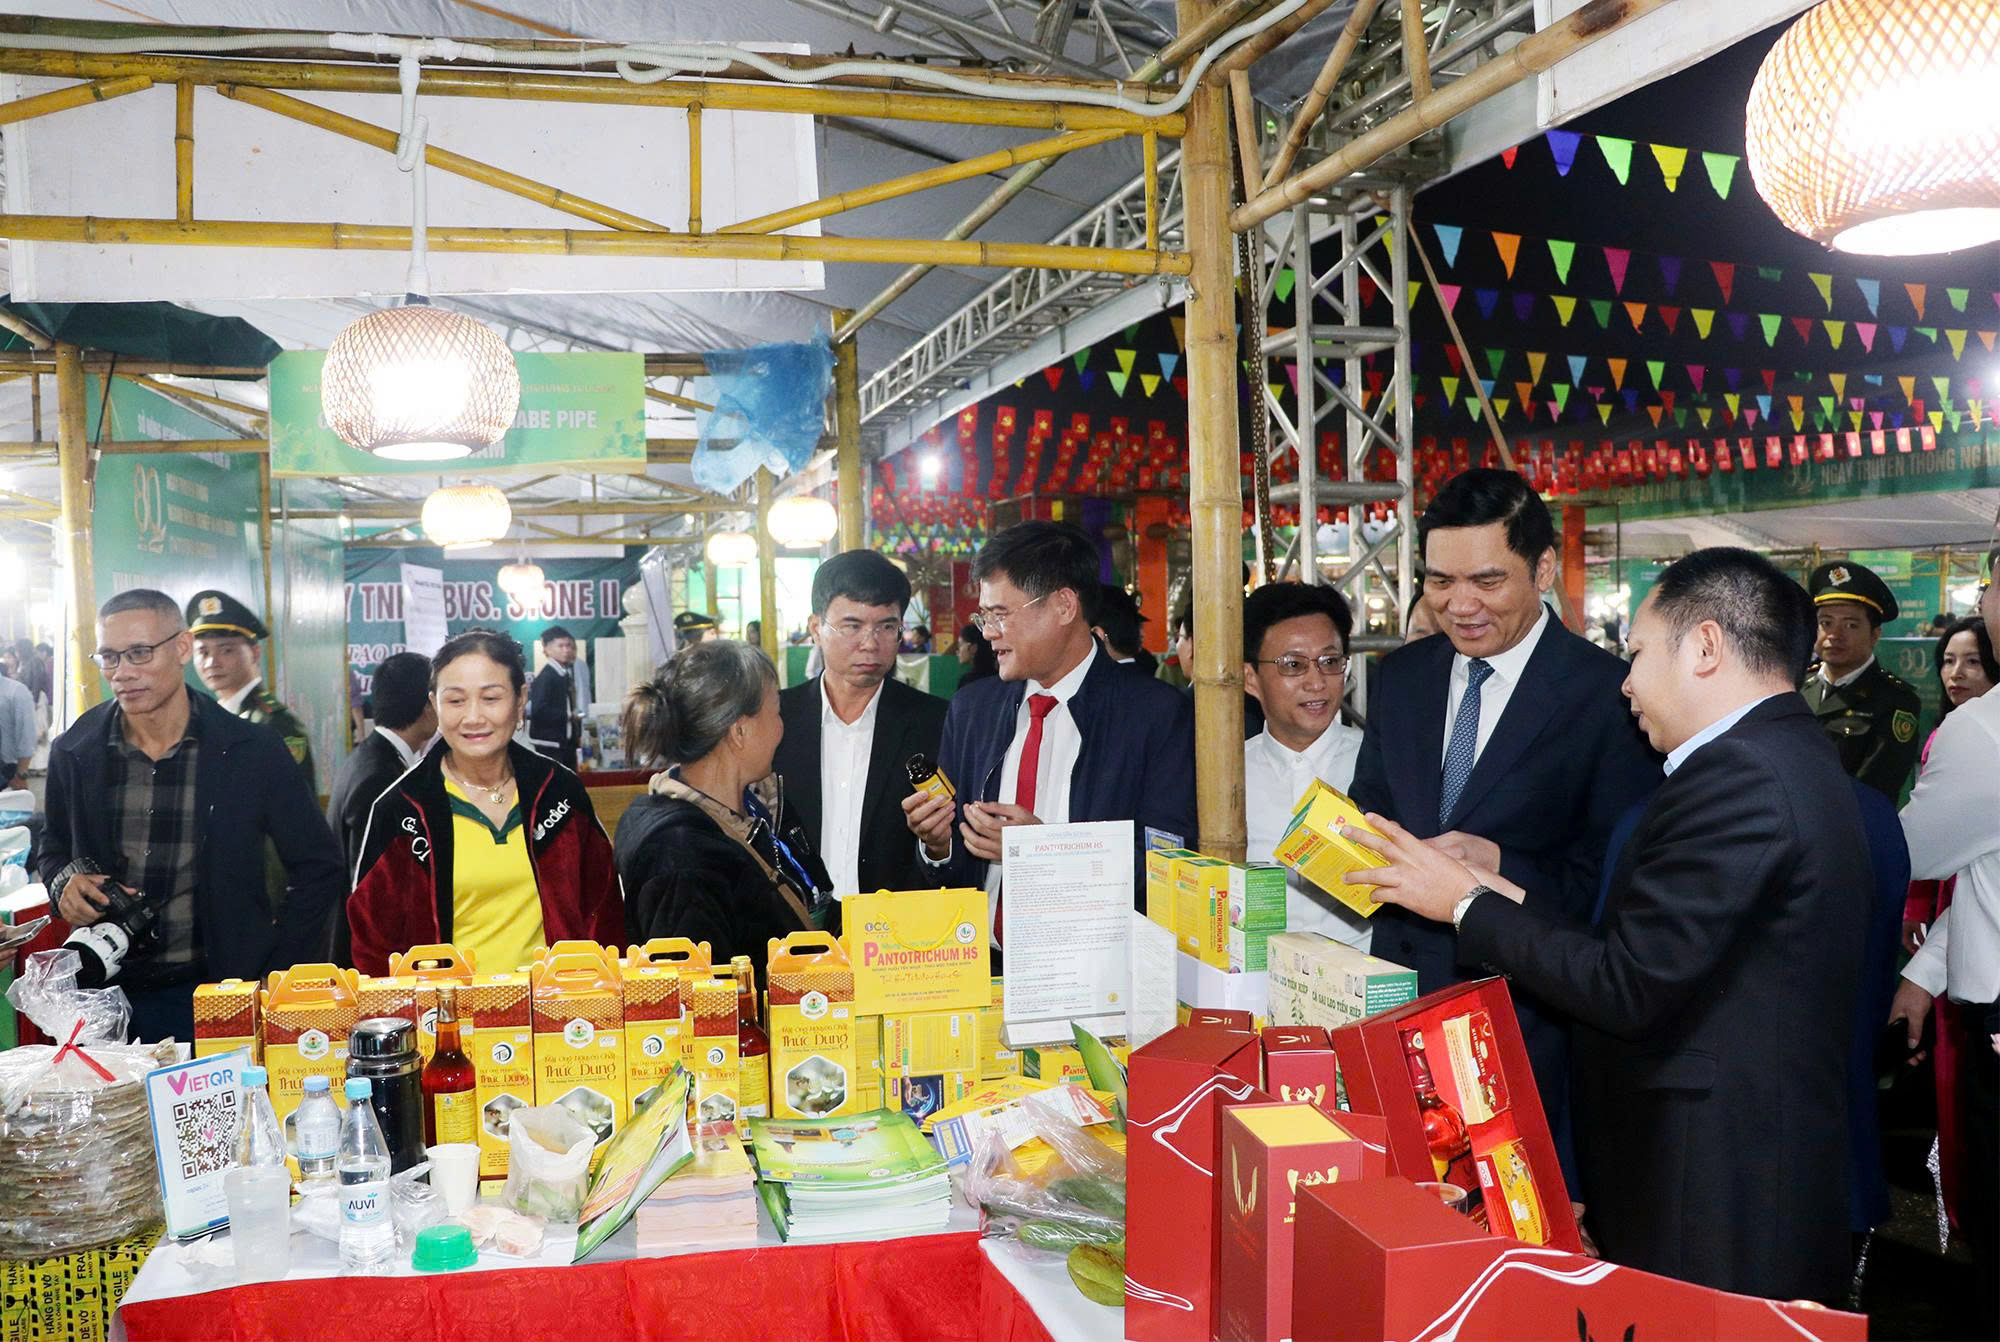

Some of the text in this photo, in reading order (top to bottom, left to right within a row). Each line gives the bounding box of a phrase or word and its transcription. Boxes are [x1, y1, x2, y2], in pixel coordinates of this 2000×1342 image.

[556, 410, 597, 429] PIPE
[1216, 890, 1228, 944] PANTOTRICHUM
[864, 942, 960, 967] PANTOTRICHUM
[962, 946, 979, 960] HS
[167, 1069, 234, 1097] VIETQR
[348, 1199, 375, 1210] AUVI
